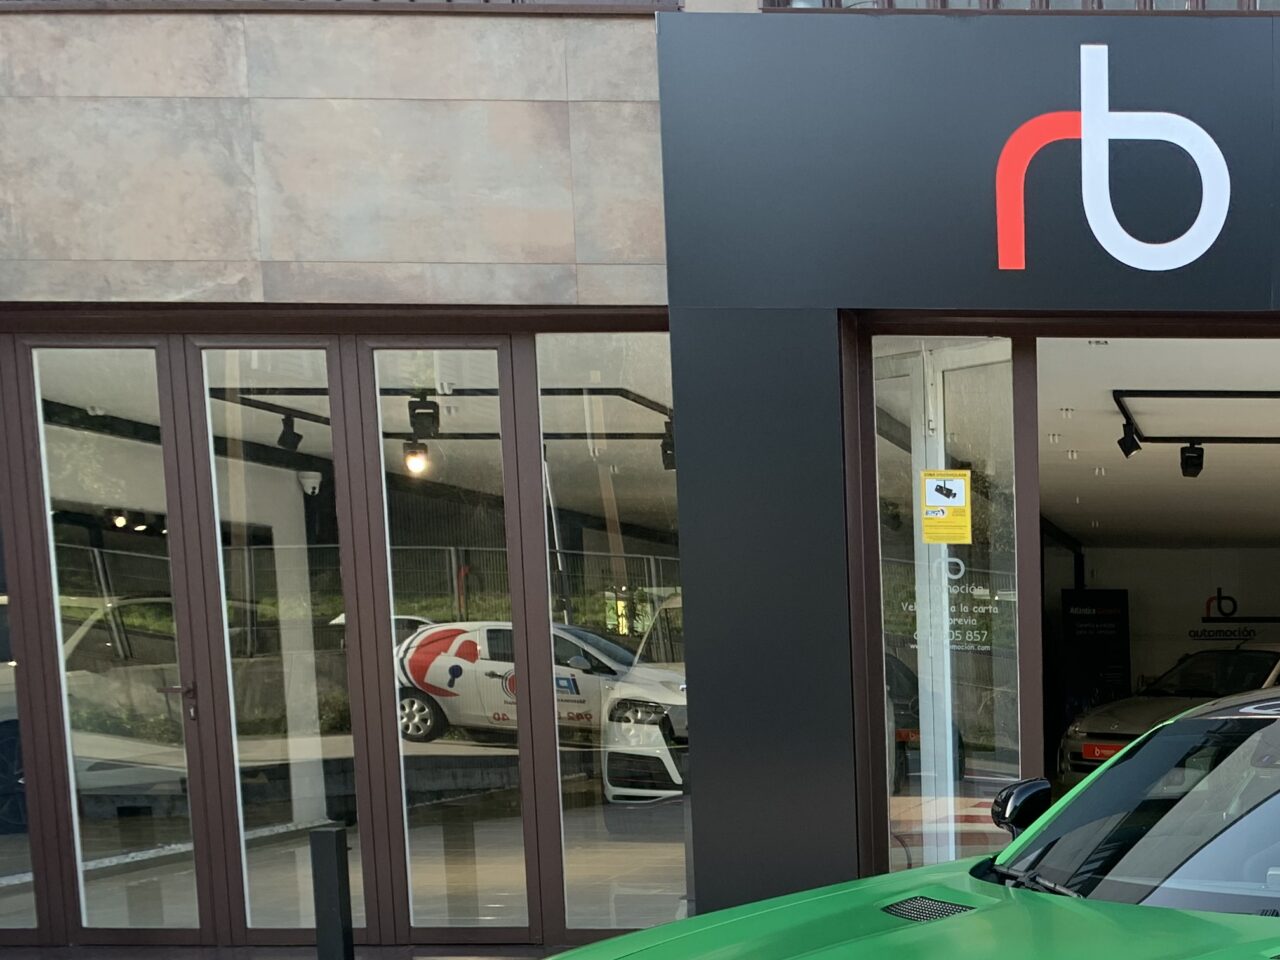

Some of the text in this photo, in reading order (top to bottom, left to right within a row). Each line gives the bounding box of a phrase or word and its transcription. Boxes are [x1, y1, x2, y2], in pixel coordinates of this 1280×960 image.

[972, 604, 999, 613] carta
[965, 630, 988, 642] 857
[1188, 626, 1256, 638] automoción
